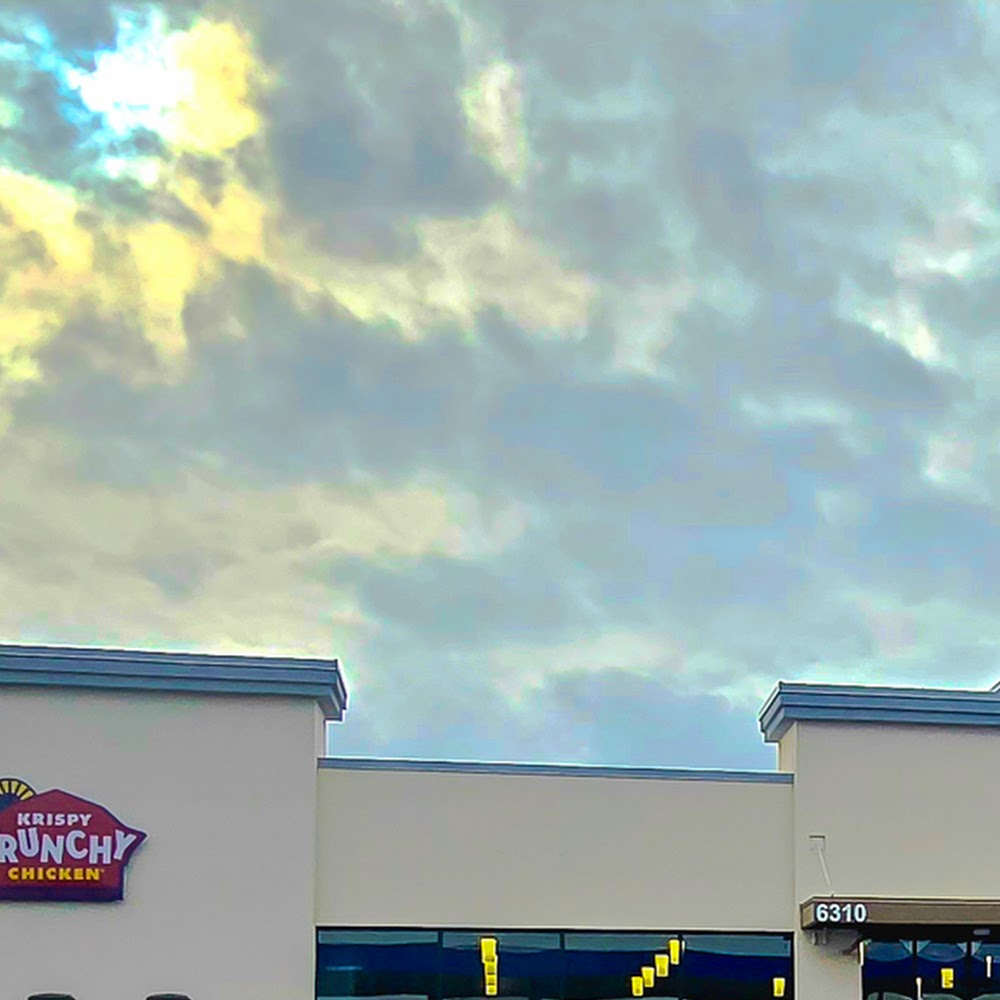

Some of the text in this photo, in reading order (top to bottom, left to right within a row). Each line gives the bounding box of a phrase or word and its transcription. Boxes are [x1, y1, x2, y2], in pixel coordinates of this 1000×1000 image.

[17, 813, 92, 827] KRISPY
[8, 867, 101, 881] CHICKEN
[816, 903, 867, 923] 6310
